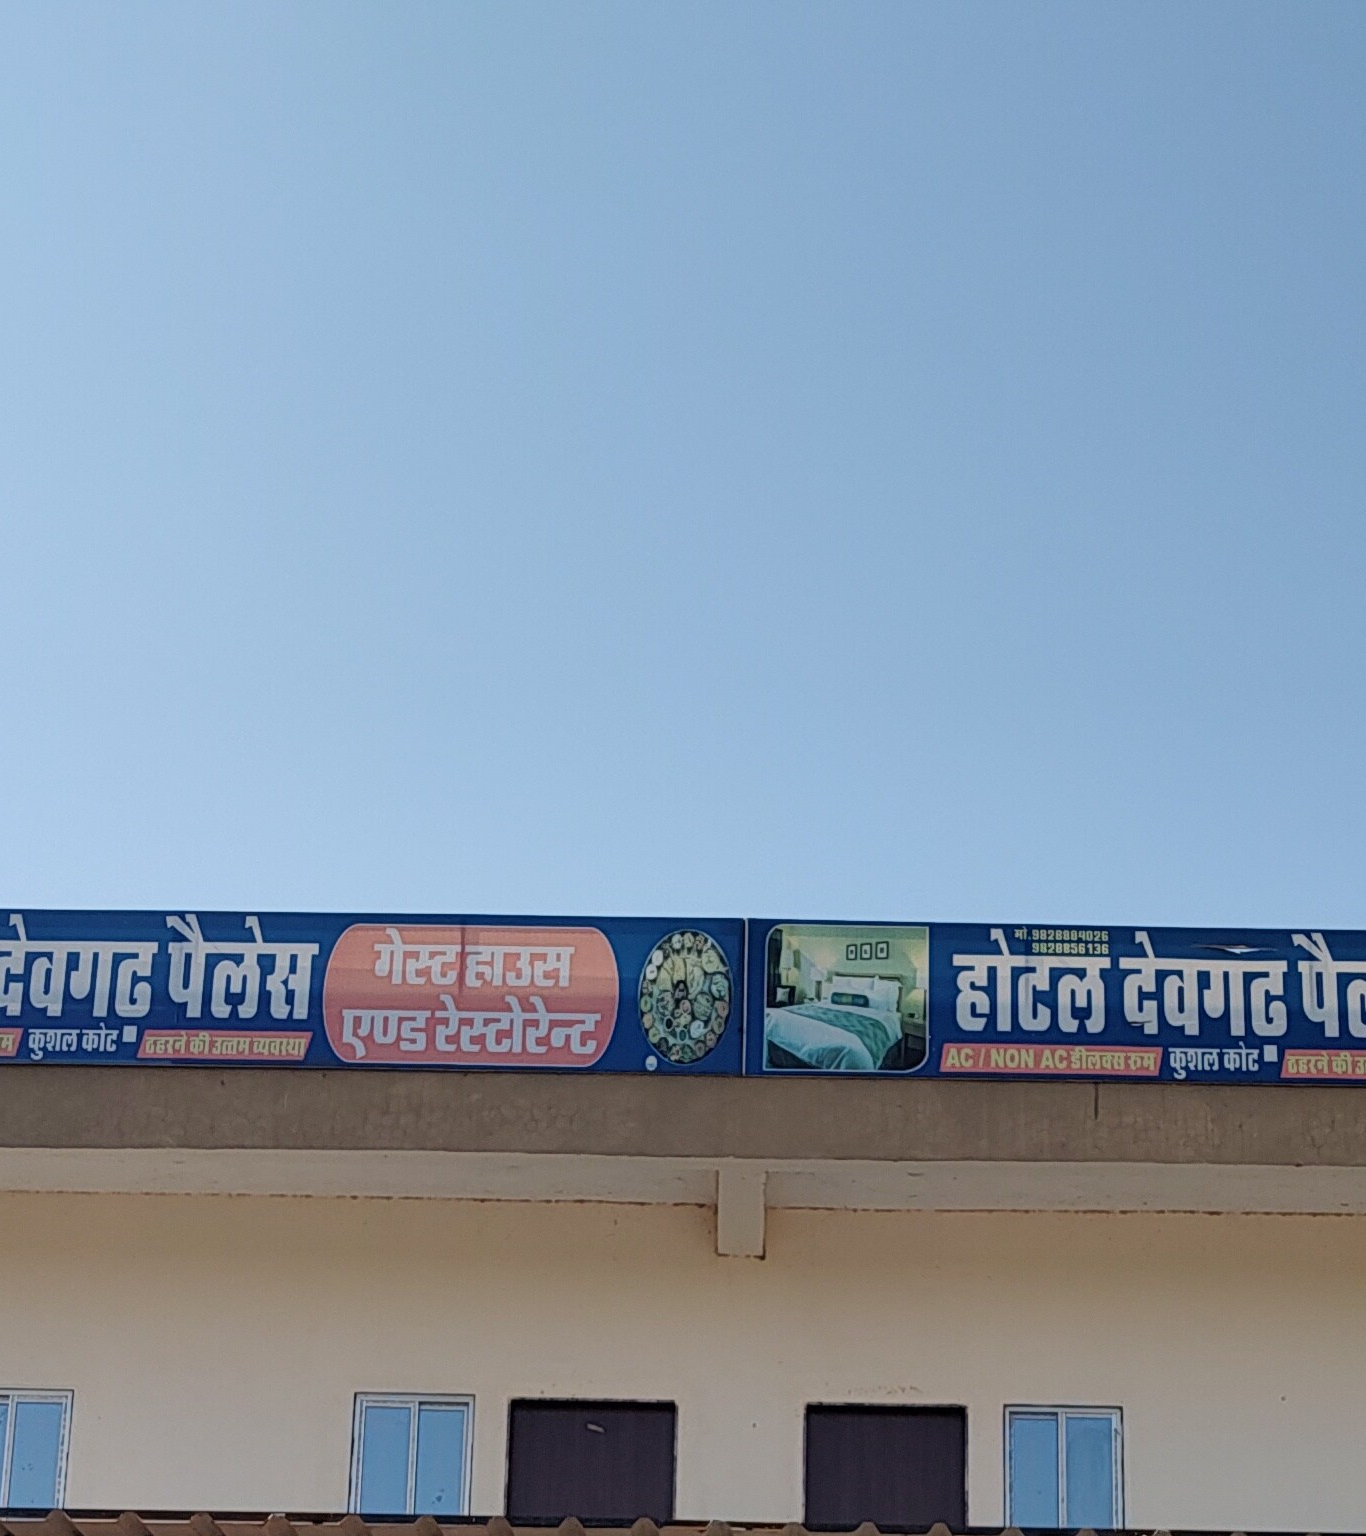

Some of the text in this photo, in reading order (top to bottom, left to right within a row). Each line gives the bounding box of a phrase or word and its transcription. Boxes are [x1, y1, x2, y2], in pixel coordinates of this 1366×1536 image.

[165, 914, 320, 1020] पैलेस
[373, 927, 576, 988] गेस्ट हाउस
[952, 928, 1111, 1034] होटल
[27, 1022, 119, 1060] कुशल कोट
[189, 1031, 211, 1055] की
[342, 994, 602, 1058] एण्ड रेस्टोरेन्ट
[946, 1048, 973, 1067] AC
[990, 1049, 1035, 1068] NON
[1040, 1050, 1068, 1069] AC
[1168, 1042, 1259, 1079] कुशल कोट
[1331, 1053, 1353, 1075] की
